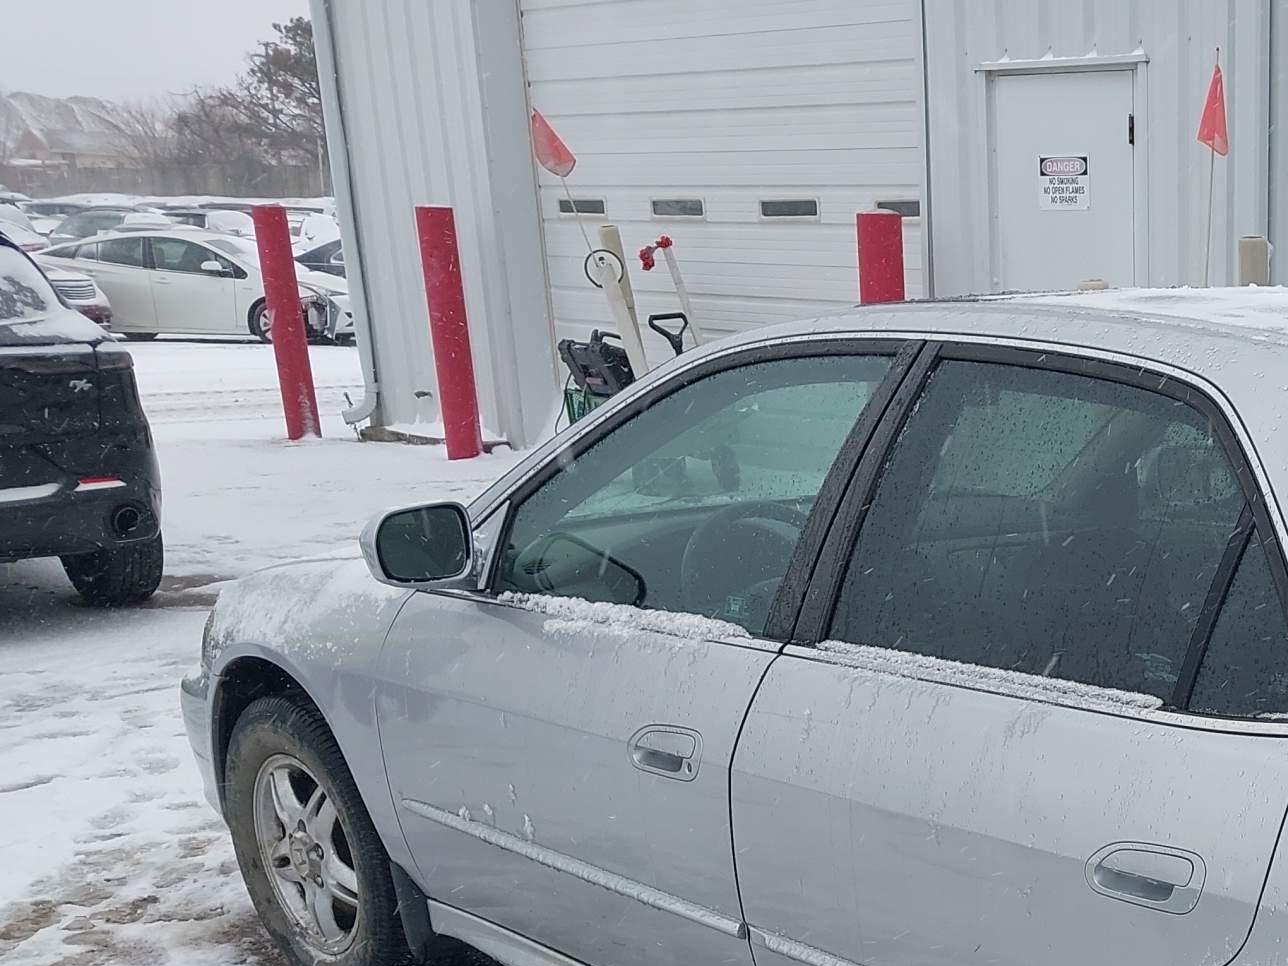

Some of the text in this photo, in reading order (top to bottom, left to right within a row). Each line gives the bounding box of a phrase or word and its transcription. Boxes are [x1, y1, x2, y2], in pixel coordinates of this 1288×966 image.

[1046, 161, 1080, 171] DANGER
[1049, 176, 1079, 185] NO SMOKING
[1044, 186, 1085, 194] NO OPEN FLAMES
[1051, 195, 1078, 204] NO SPARKS
